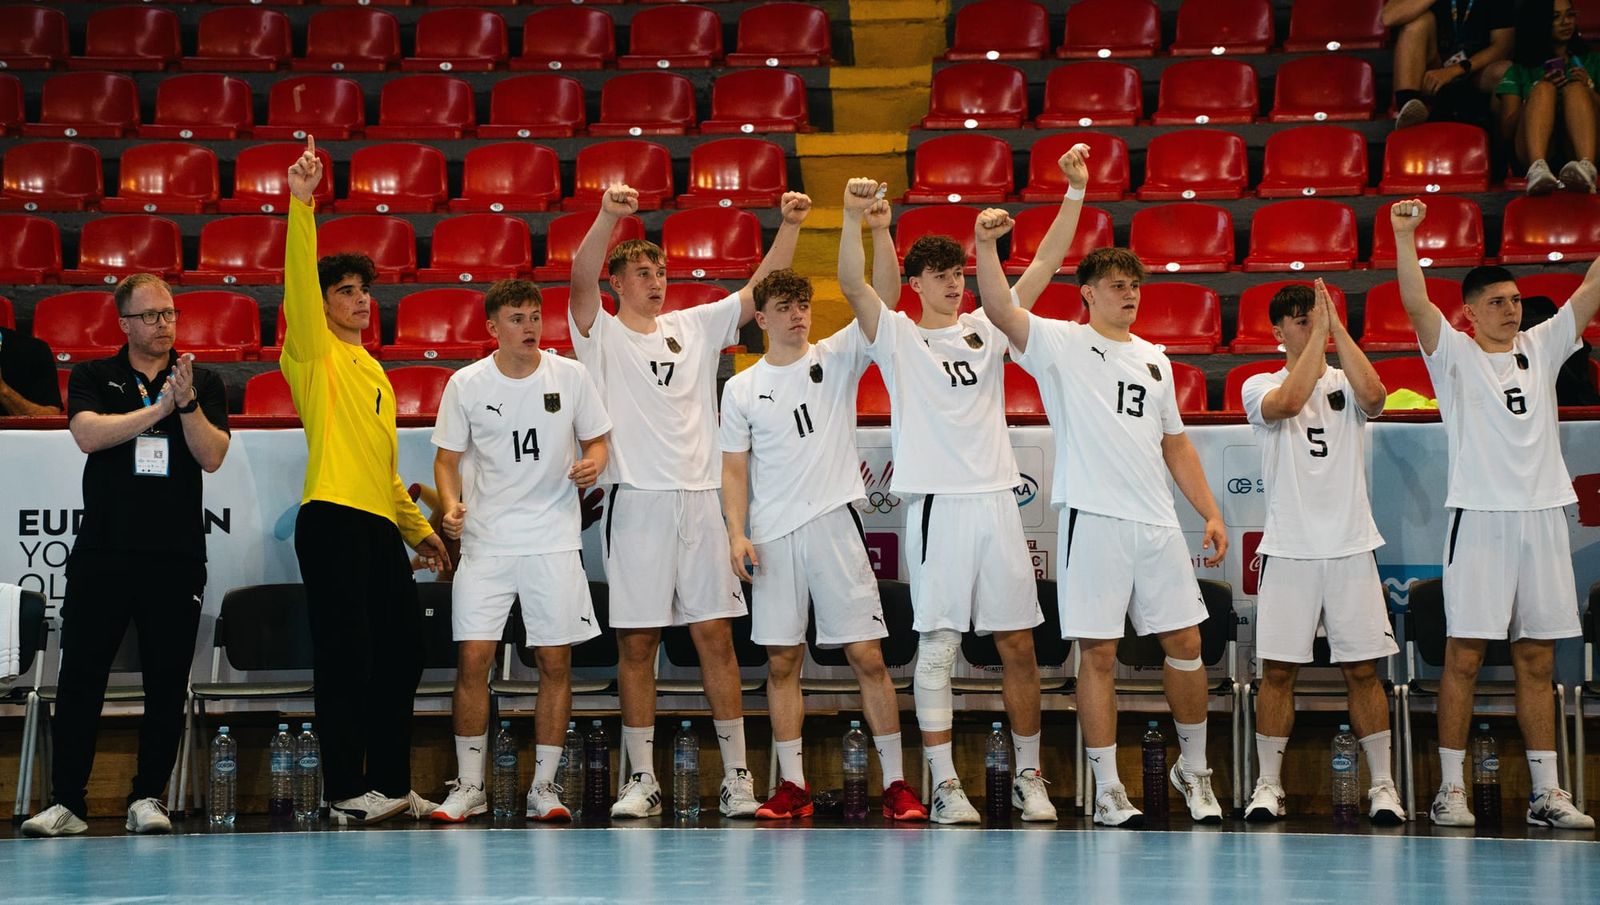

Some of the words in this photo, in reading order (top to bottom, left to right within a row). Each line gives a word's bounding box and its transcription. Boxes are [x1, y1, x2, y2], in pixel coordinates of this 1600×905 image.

[650, 361, 675, 387] 17
[943, 360, 978, 387] 10
[375, 388, 382, 416] 1
[1116, 381, 1147, 418] 13
[1503, 387, 1527, 415] 6
[793, 403, 814, 438] 11
[512, 428, 540, 462] 14
[1307, 427, 1328, 457] 5
